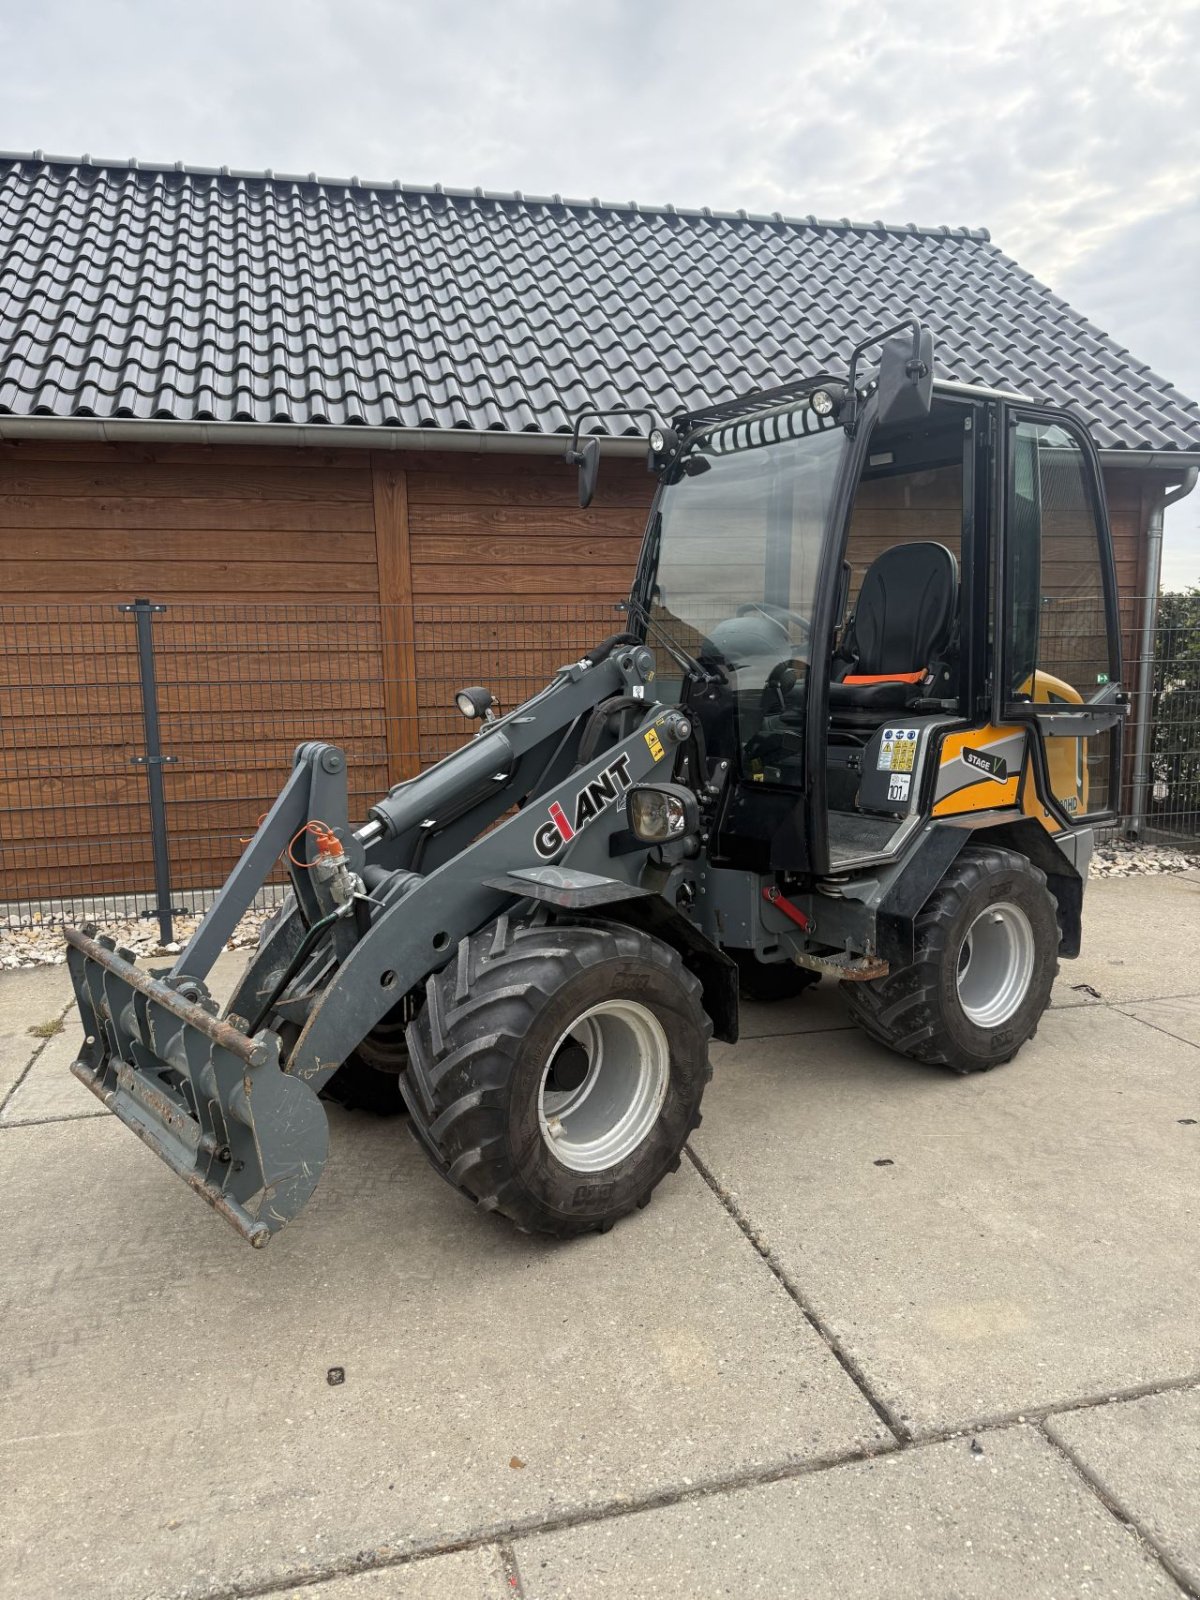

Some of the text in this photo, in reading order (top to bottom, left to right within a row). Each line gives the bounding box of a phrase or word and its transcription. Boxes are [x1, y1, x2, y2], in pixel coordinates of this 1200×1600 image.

[967, 753, 1005, 773] STAGE V
[890, 785, 903, 800] 101
